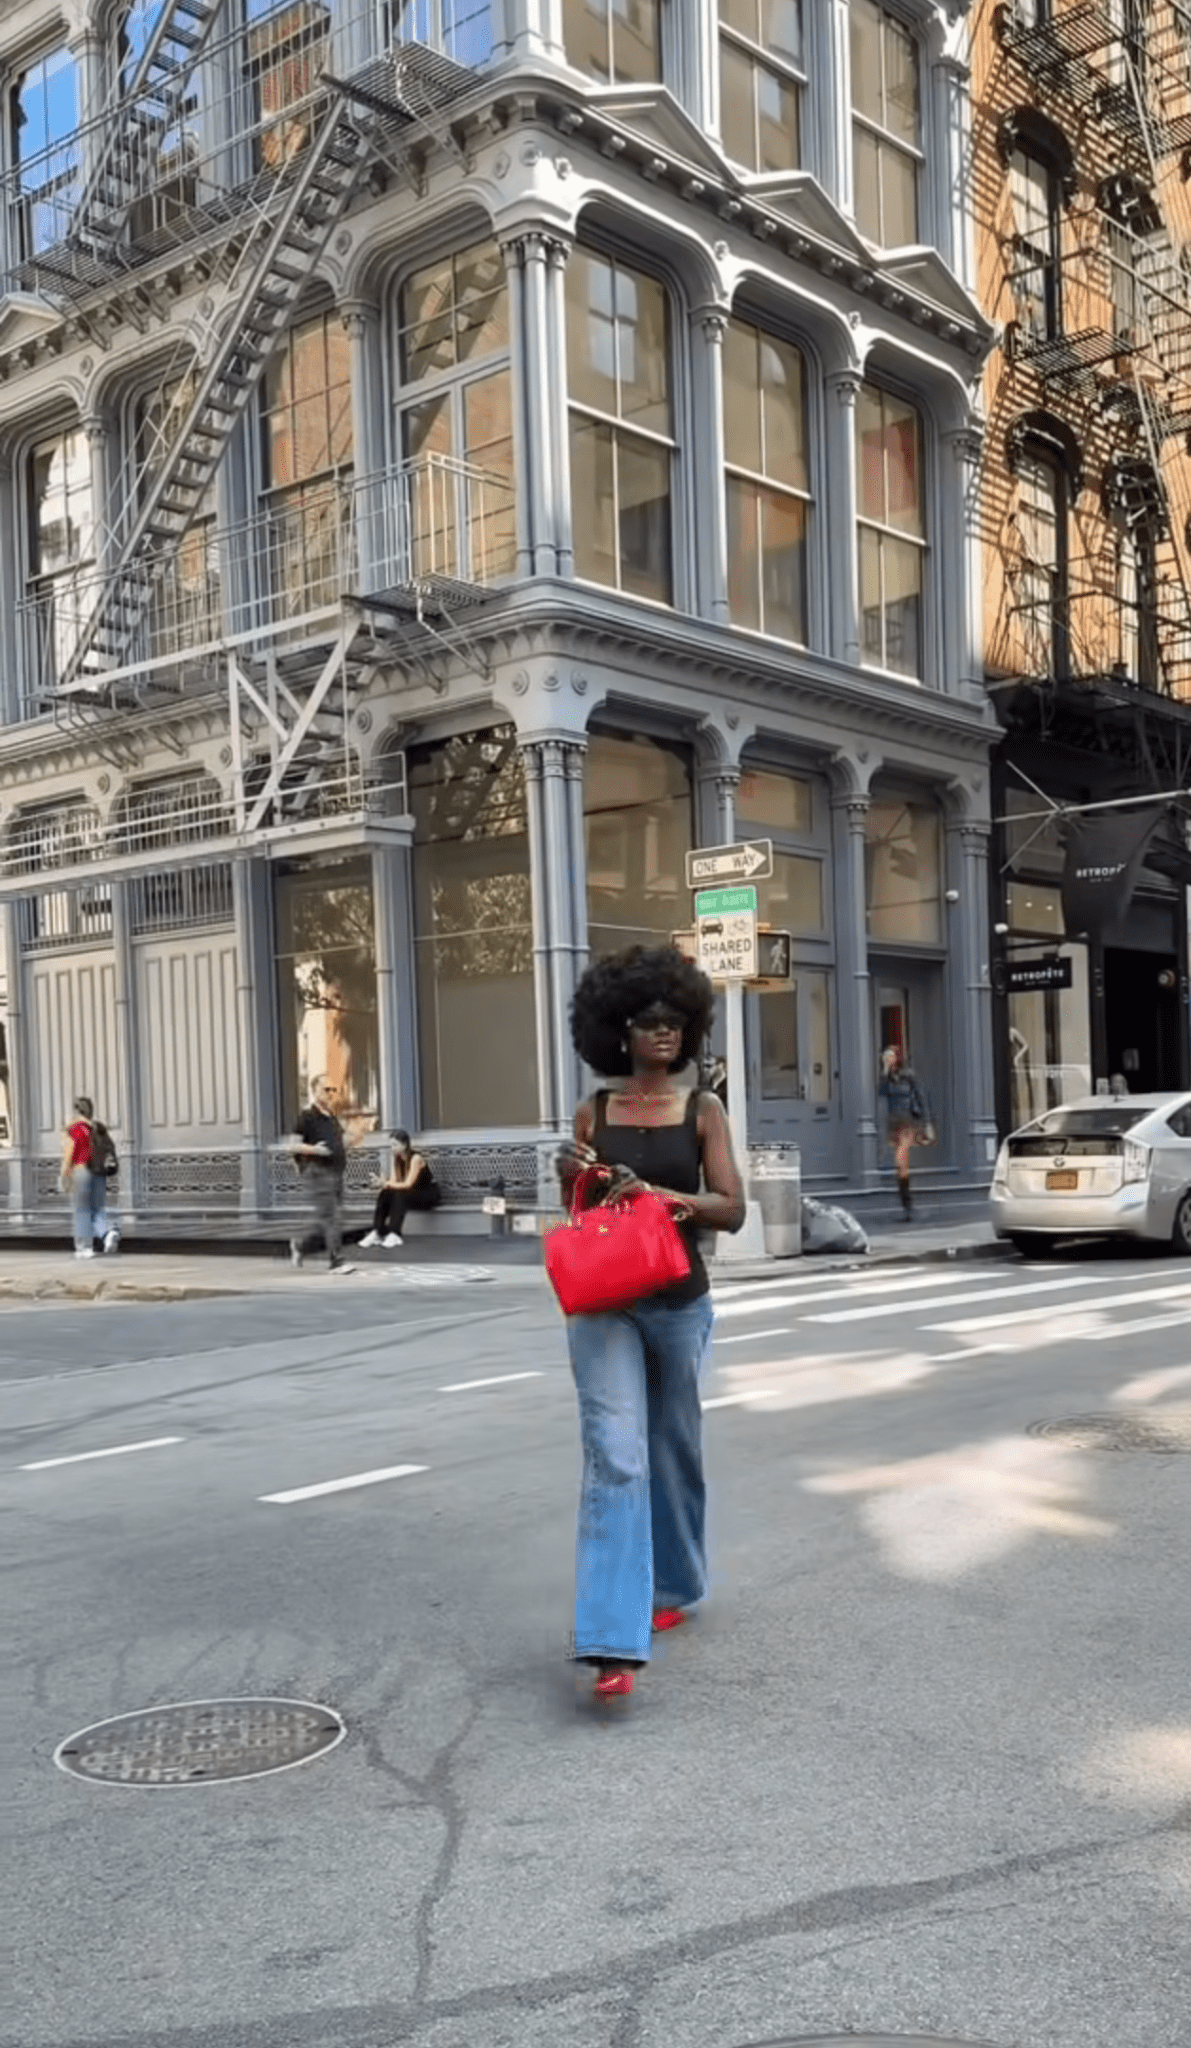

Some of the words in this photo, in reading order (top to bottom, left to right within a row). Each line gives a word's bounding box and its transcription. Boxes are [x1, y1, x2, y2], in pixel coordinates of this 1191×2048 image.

[696, 857, 718, 875] ONE
[732, 853, 756, 869] WAY
[702, 939, 751, 956] SHARED
[711, 956, 743, 972] LANE
